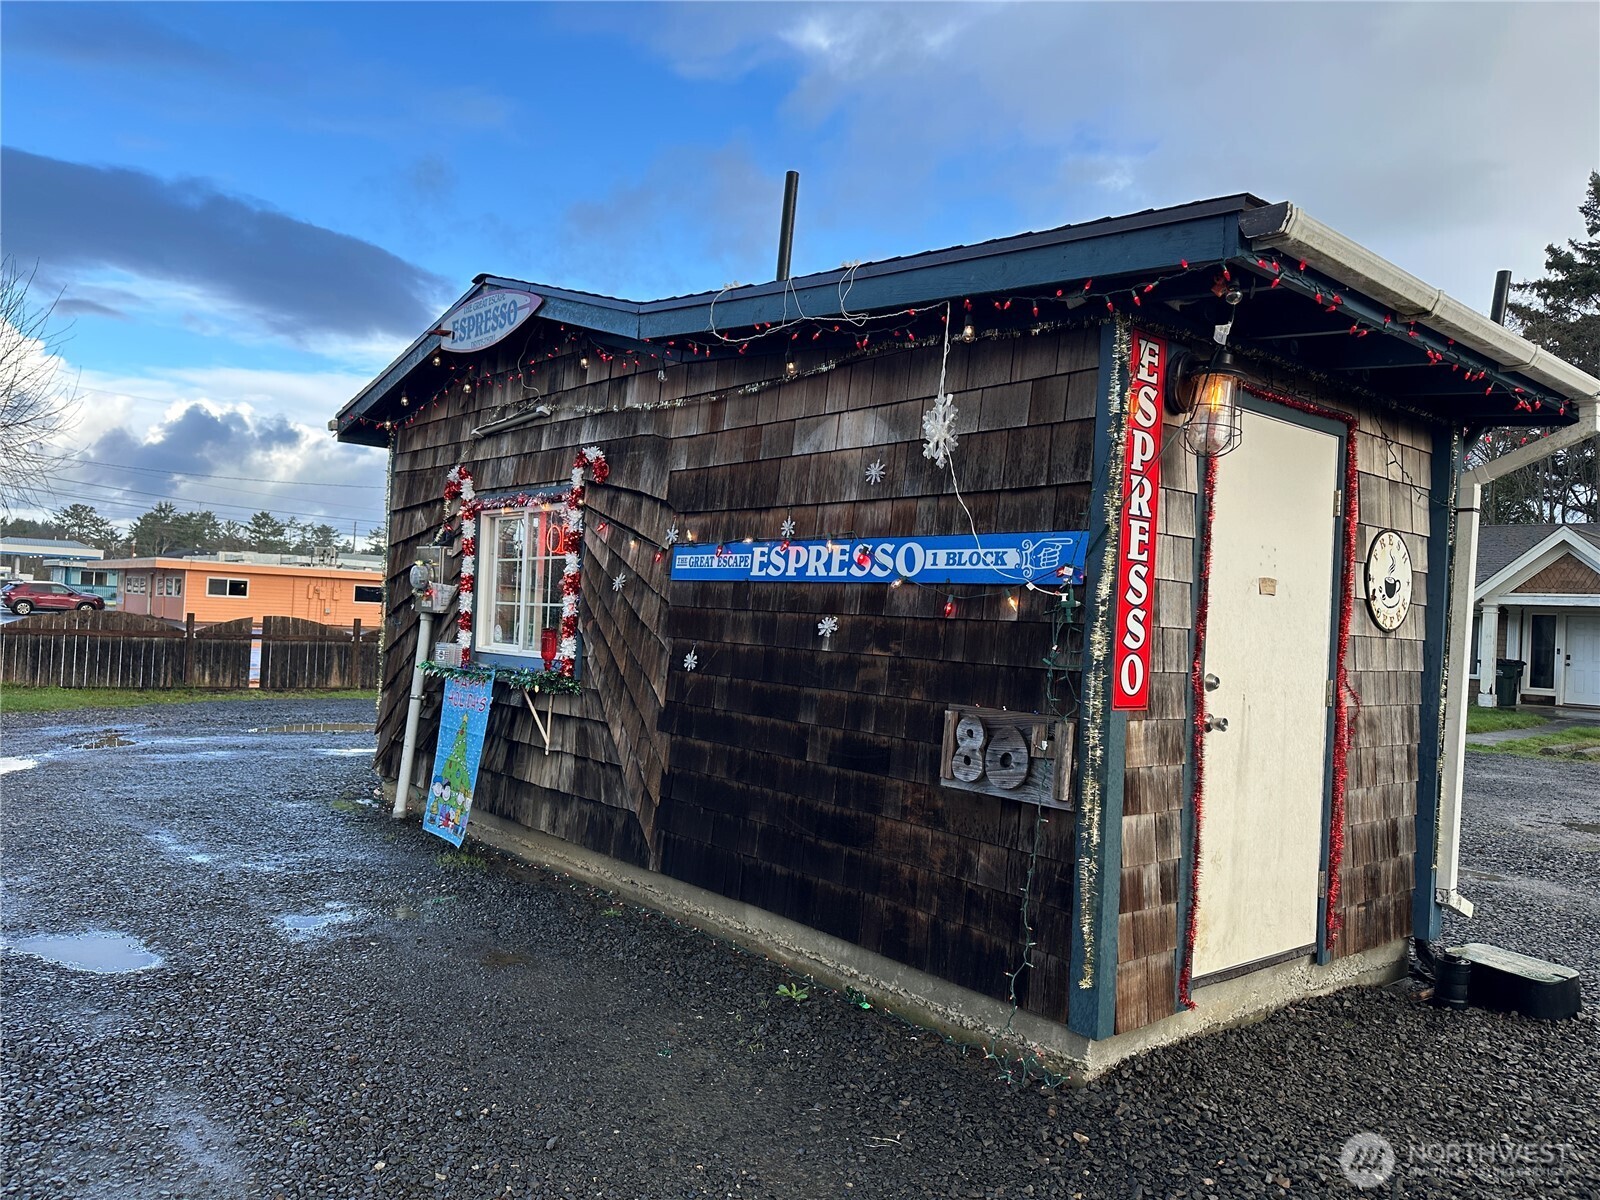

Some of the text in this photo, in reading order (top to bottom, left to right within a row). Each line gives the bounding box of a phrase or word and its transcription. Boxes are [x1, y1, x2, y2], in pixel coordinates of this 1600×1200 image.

[451, 299, 518, 344] ESPRESSO
[463, 293, 506, 314] THE GREAT ESCAPE
[1120, 338, 1160, 697] ESPRESSO
[677, 541, 1009, 578] THE GREAT ESCAPE ESPRESSO 1 BLOCK
[1373, 534, 1408, 565] FRESH
